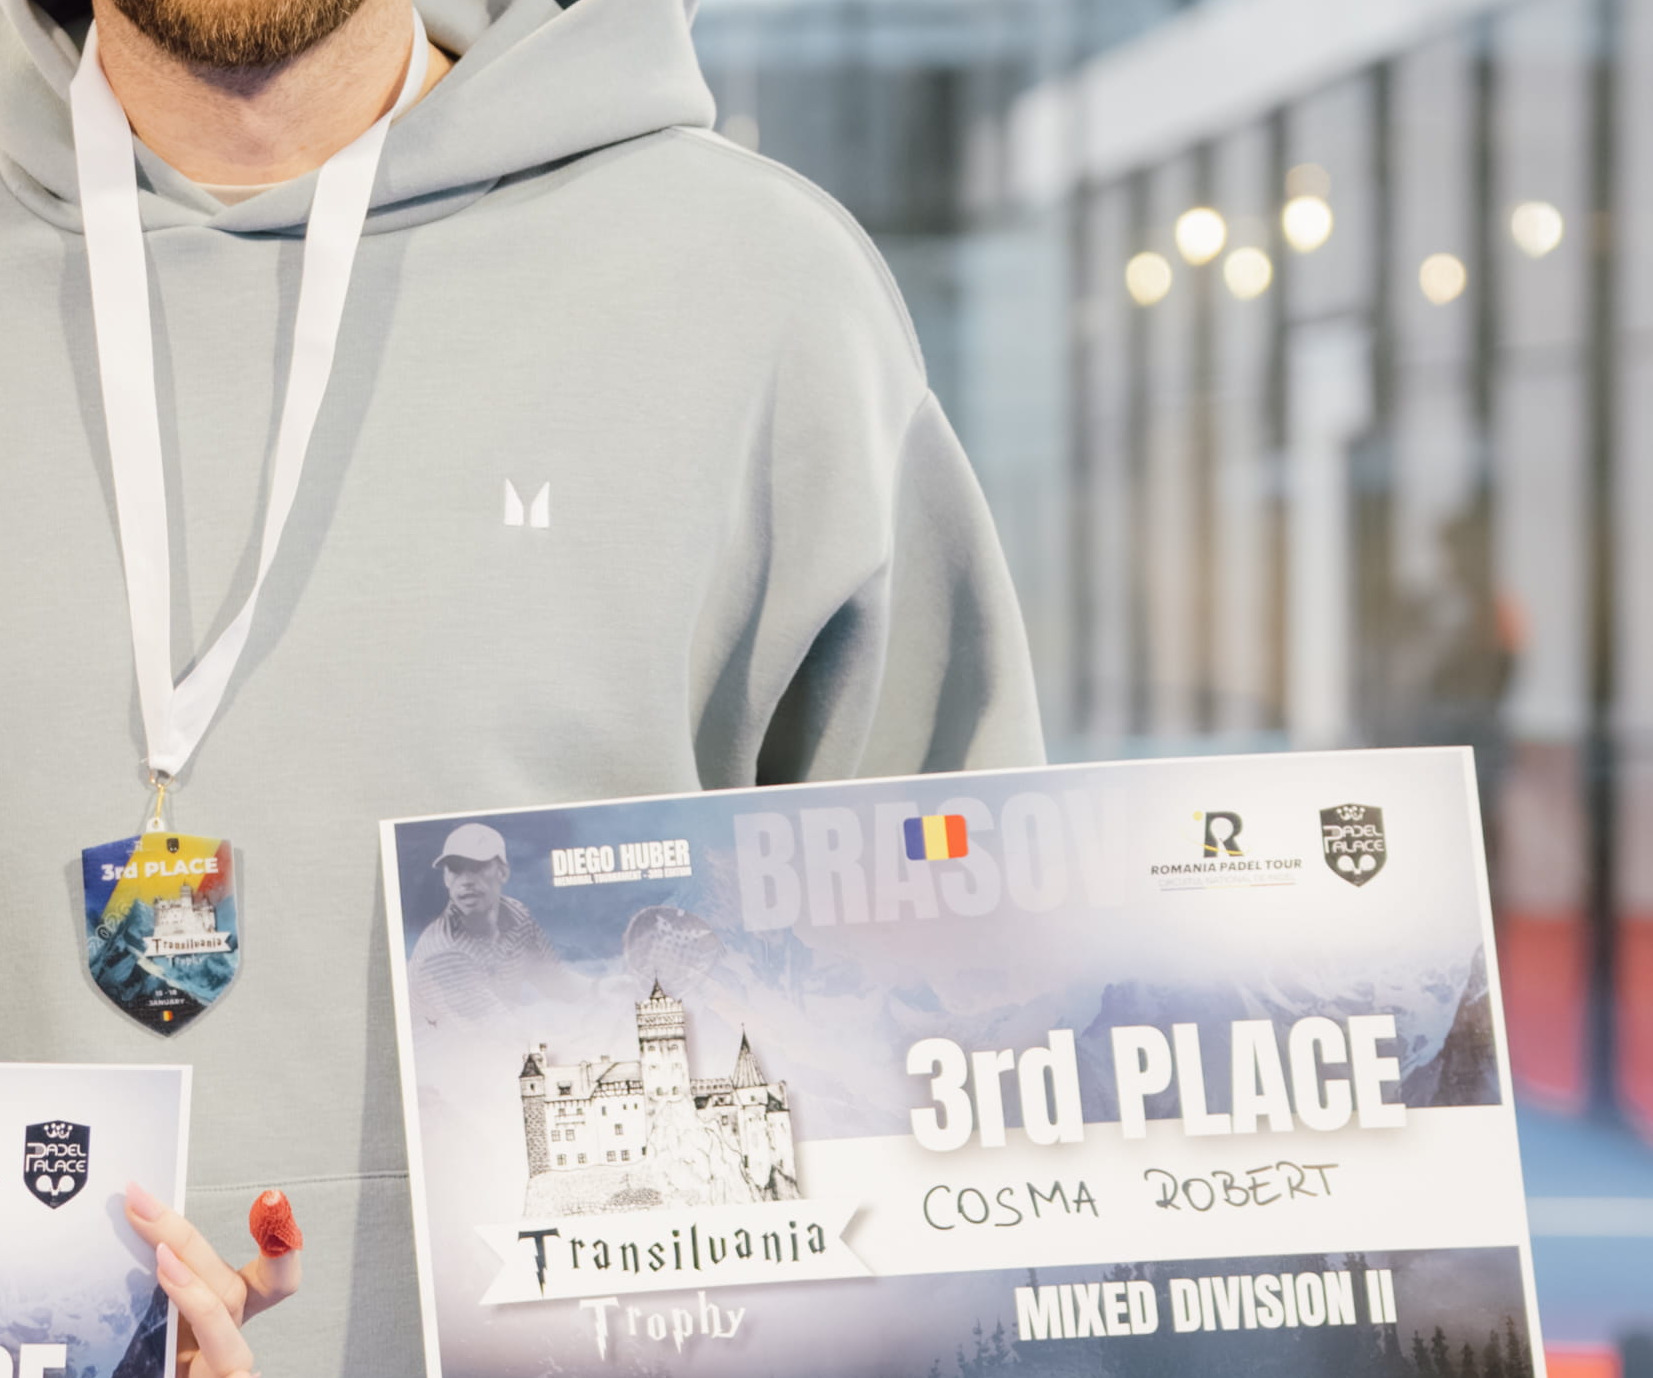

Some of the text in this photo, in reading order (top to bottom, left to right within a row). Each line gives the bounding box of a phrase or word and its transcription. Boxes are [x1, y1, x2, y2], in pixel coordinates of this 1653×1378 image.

[552, 839, 690, 876] DIEGO HUBER
[733, 788, 1134, 931] BRASOV
[1324, 836, 1385, 854] PALACE
[101, 857, 219, 881] 3rd PLACE
[1151, 858, 1302, 875] ROMANIA PADEL TOUR
[152, 937, 222, 954] Transilvania
[148, 998, 185, 1007] JANUARY
[906, 1013, 1407, 1153] 3rd PLACE
[25, 1154, 86, 1173] PALACE
[922, 1160, 1339, 1231] COSMA ROBERT
[517, 1220, 828, 1297] Transilvania
[1014, 1268, 1397, 1342] MIXED DIVISION II
[579, 1290, 747, 1362] Trophy
